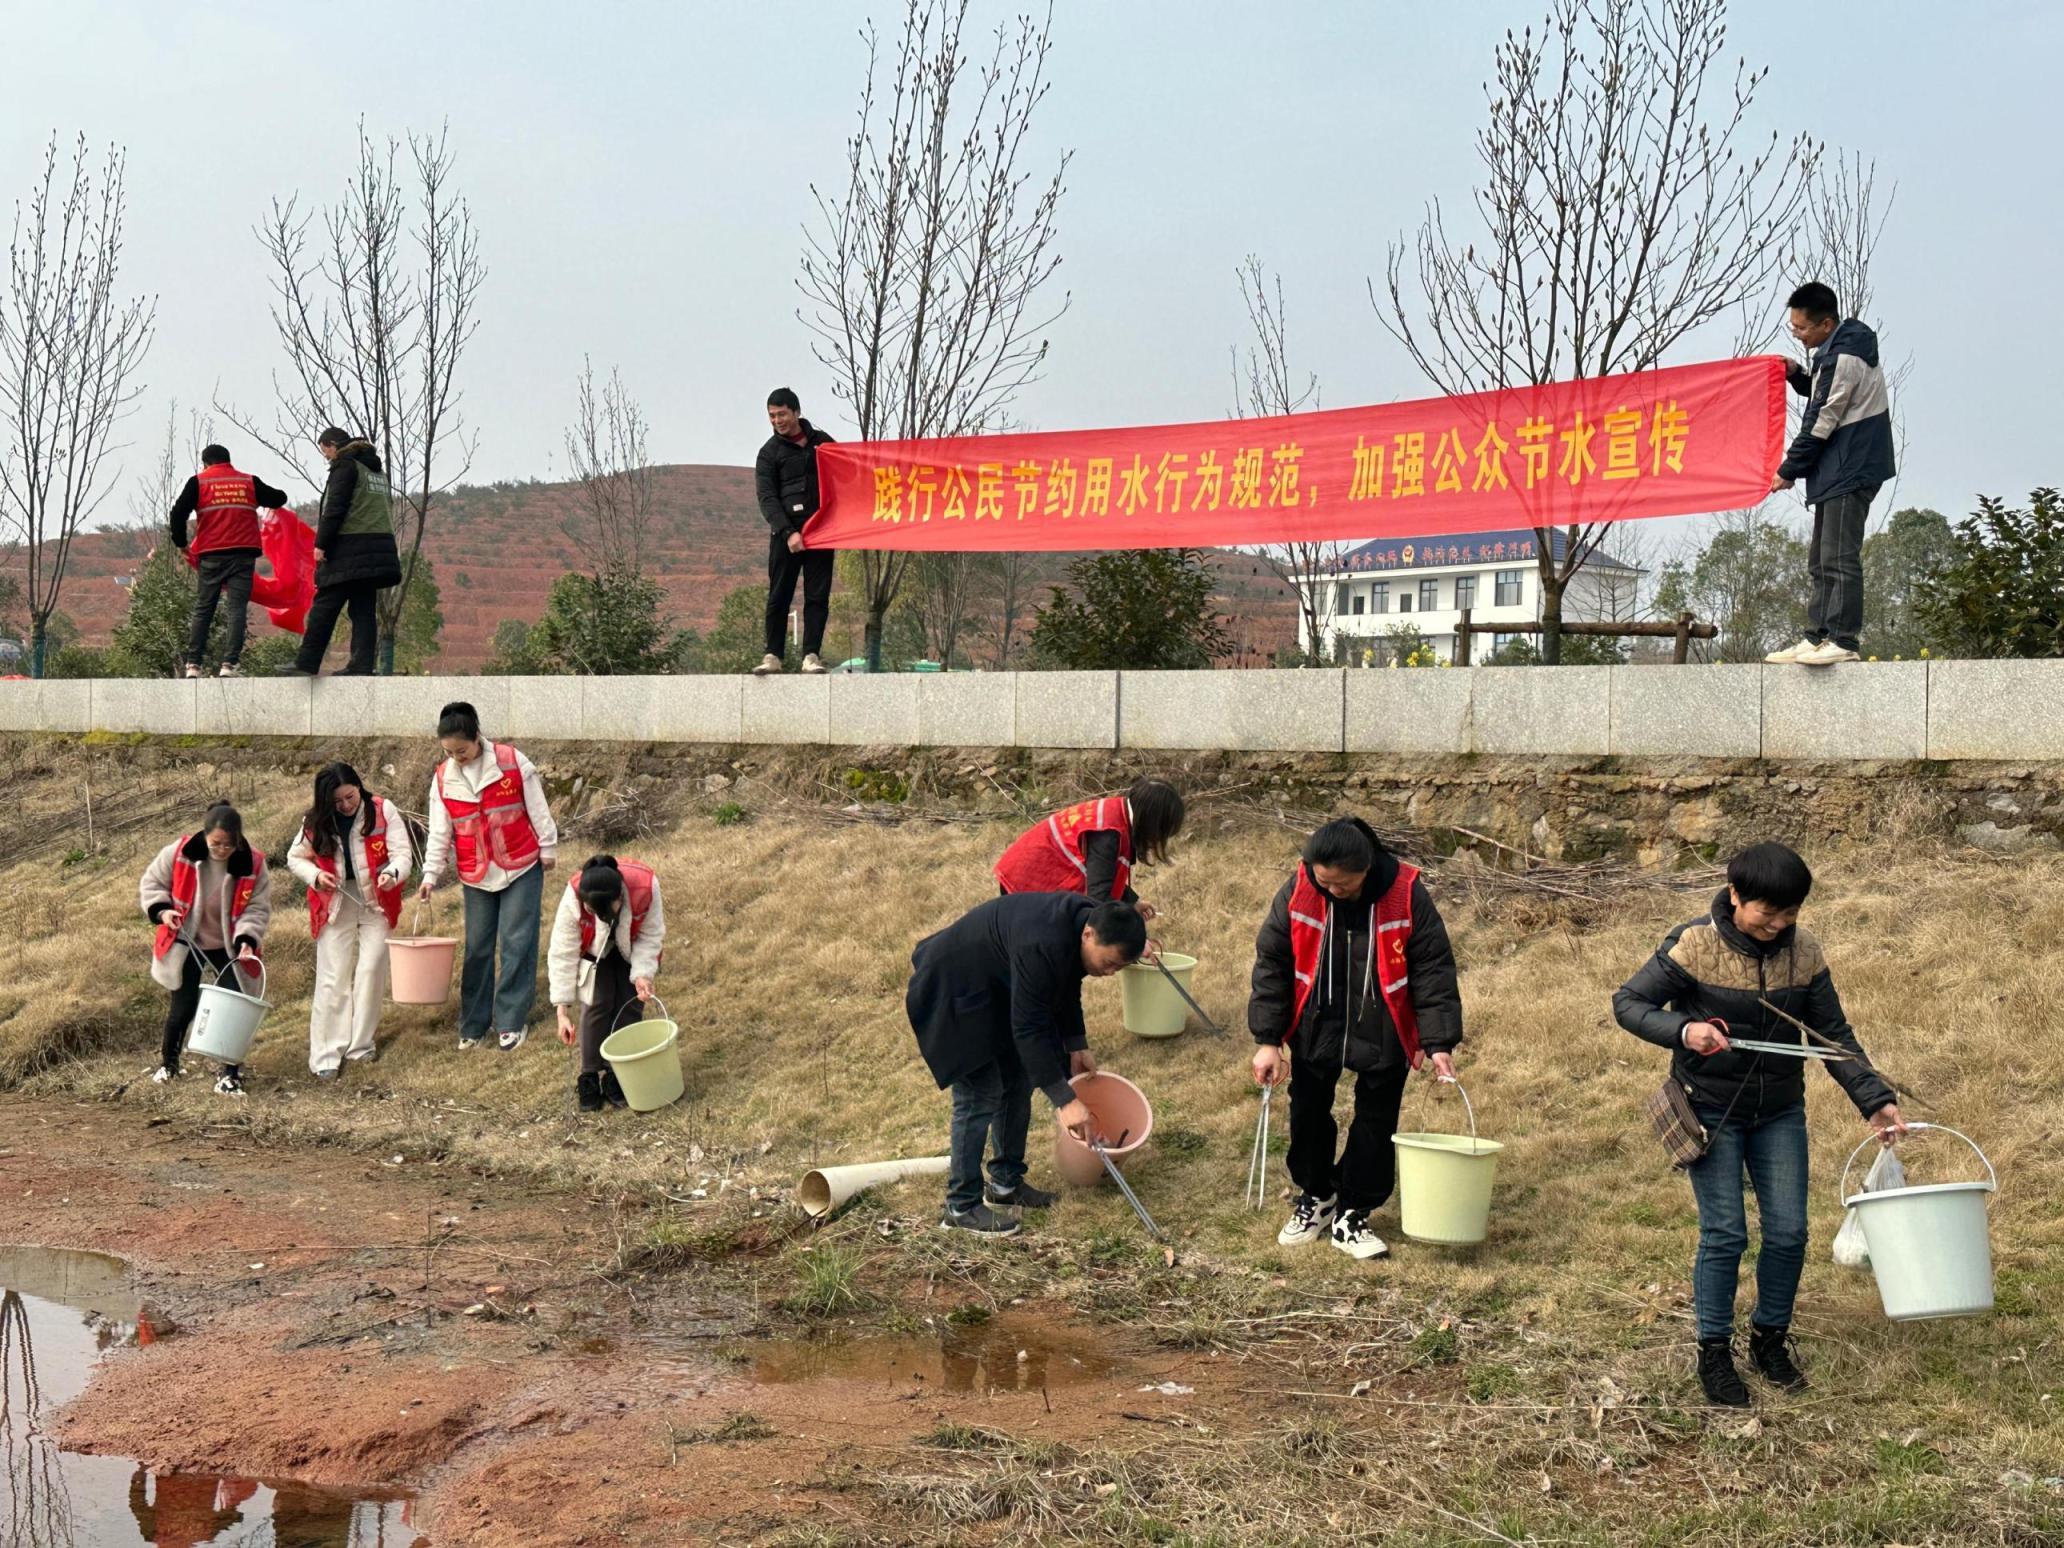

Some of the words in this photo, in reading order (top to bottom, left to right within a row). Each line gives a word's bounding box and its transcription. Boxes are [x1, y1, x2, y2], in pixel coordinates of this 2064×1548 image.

[872, 399, 1690, 524] 践行公民节约用水行为规范，加强公众节水宣传
